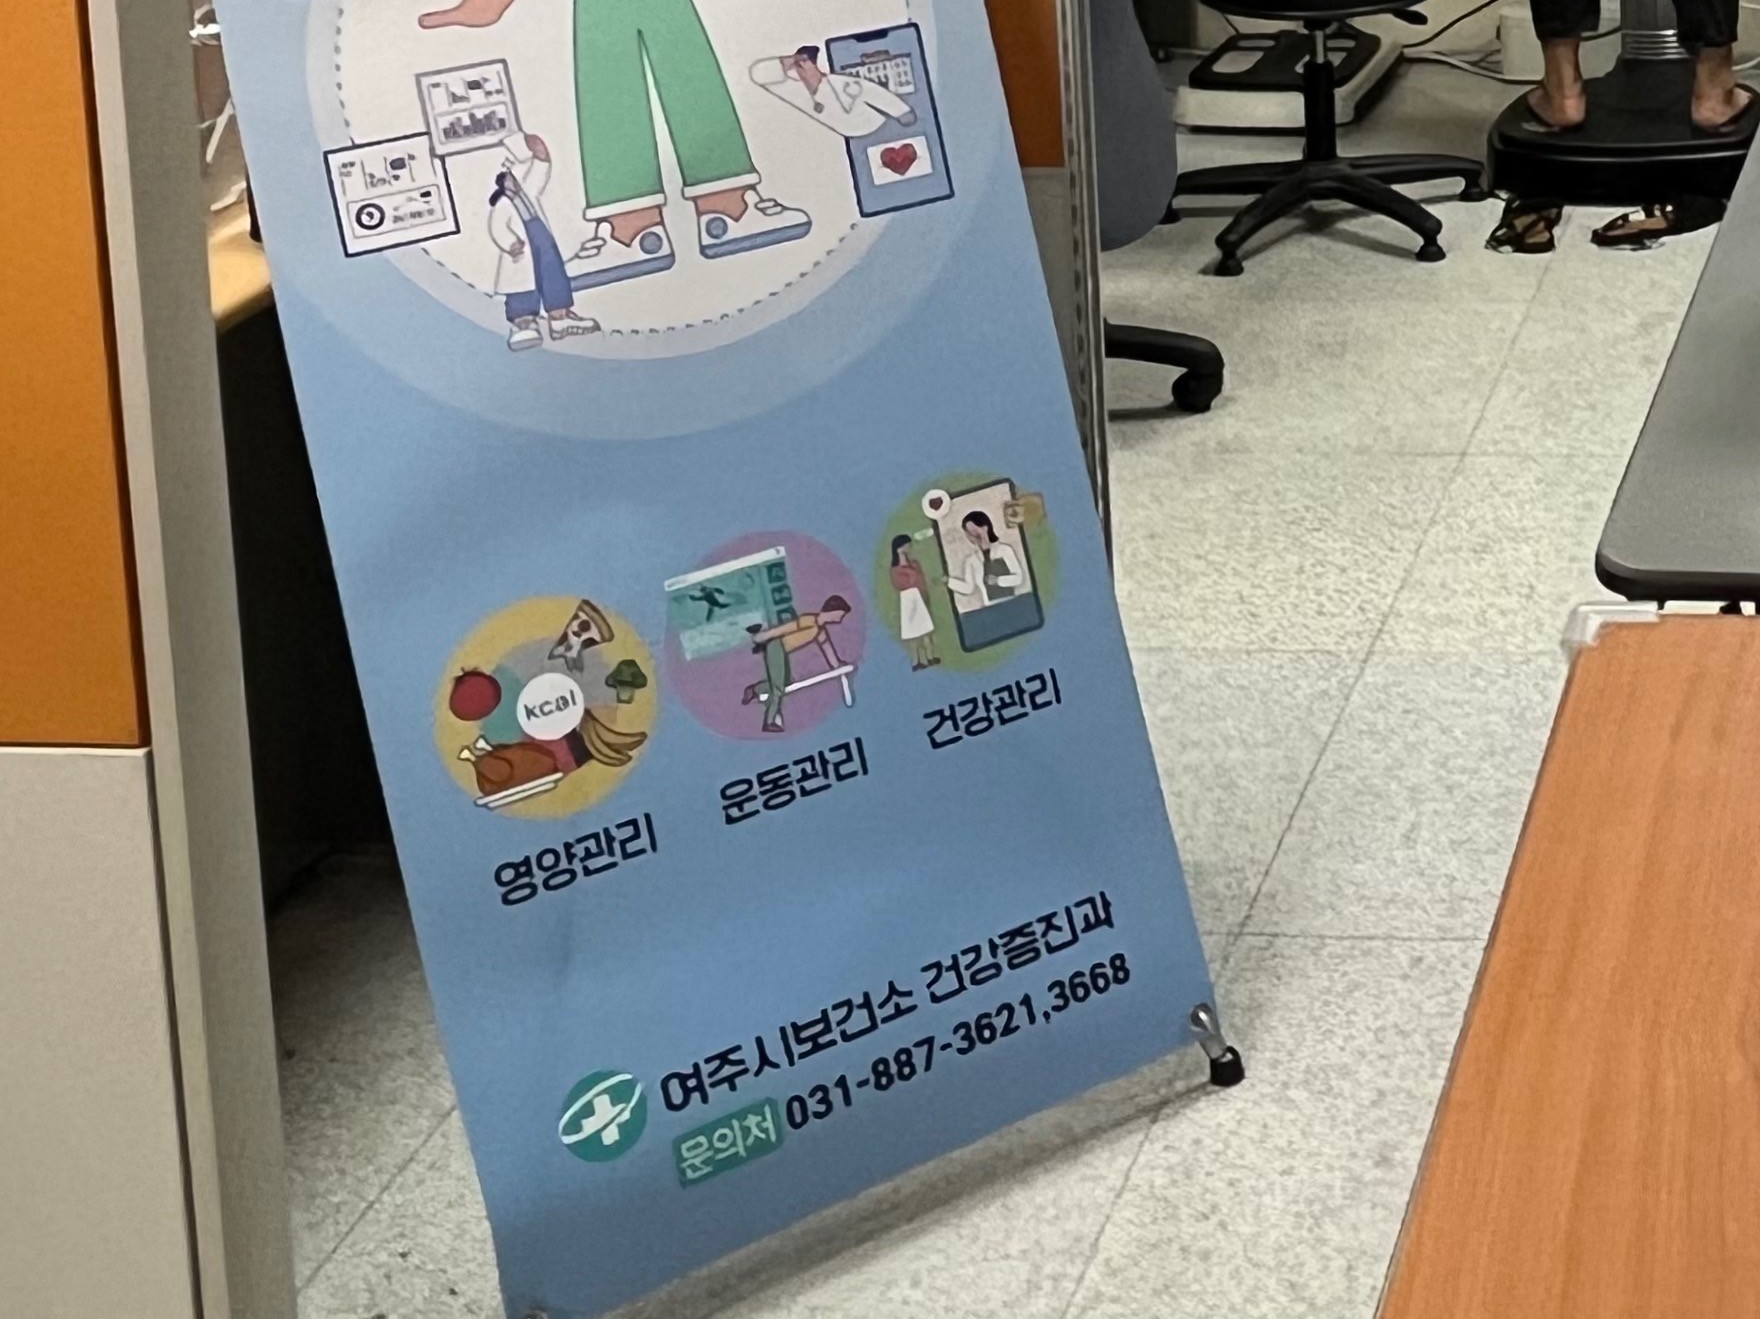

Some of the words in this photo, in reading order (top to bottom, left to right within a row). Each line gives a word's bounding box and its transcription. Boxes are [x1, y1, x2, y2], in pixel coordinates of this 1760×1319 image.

[922, 668, 1064, 750] 건강관리
[718, 736, 870, 824] 운동관리
[493, 813, 660, 906] 영양관리
[660, 977, 919, 1114] 여주시보건소
[920, 891, 1117, 1001] 건강증진과
[678, 1100, 782, 1178] 문의처
[785, 954, 1133, 1132] 031-887-3621,3668
